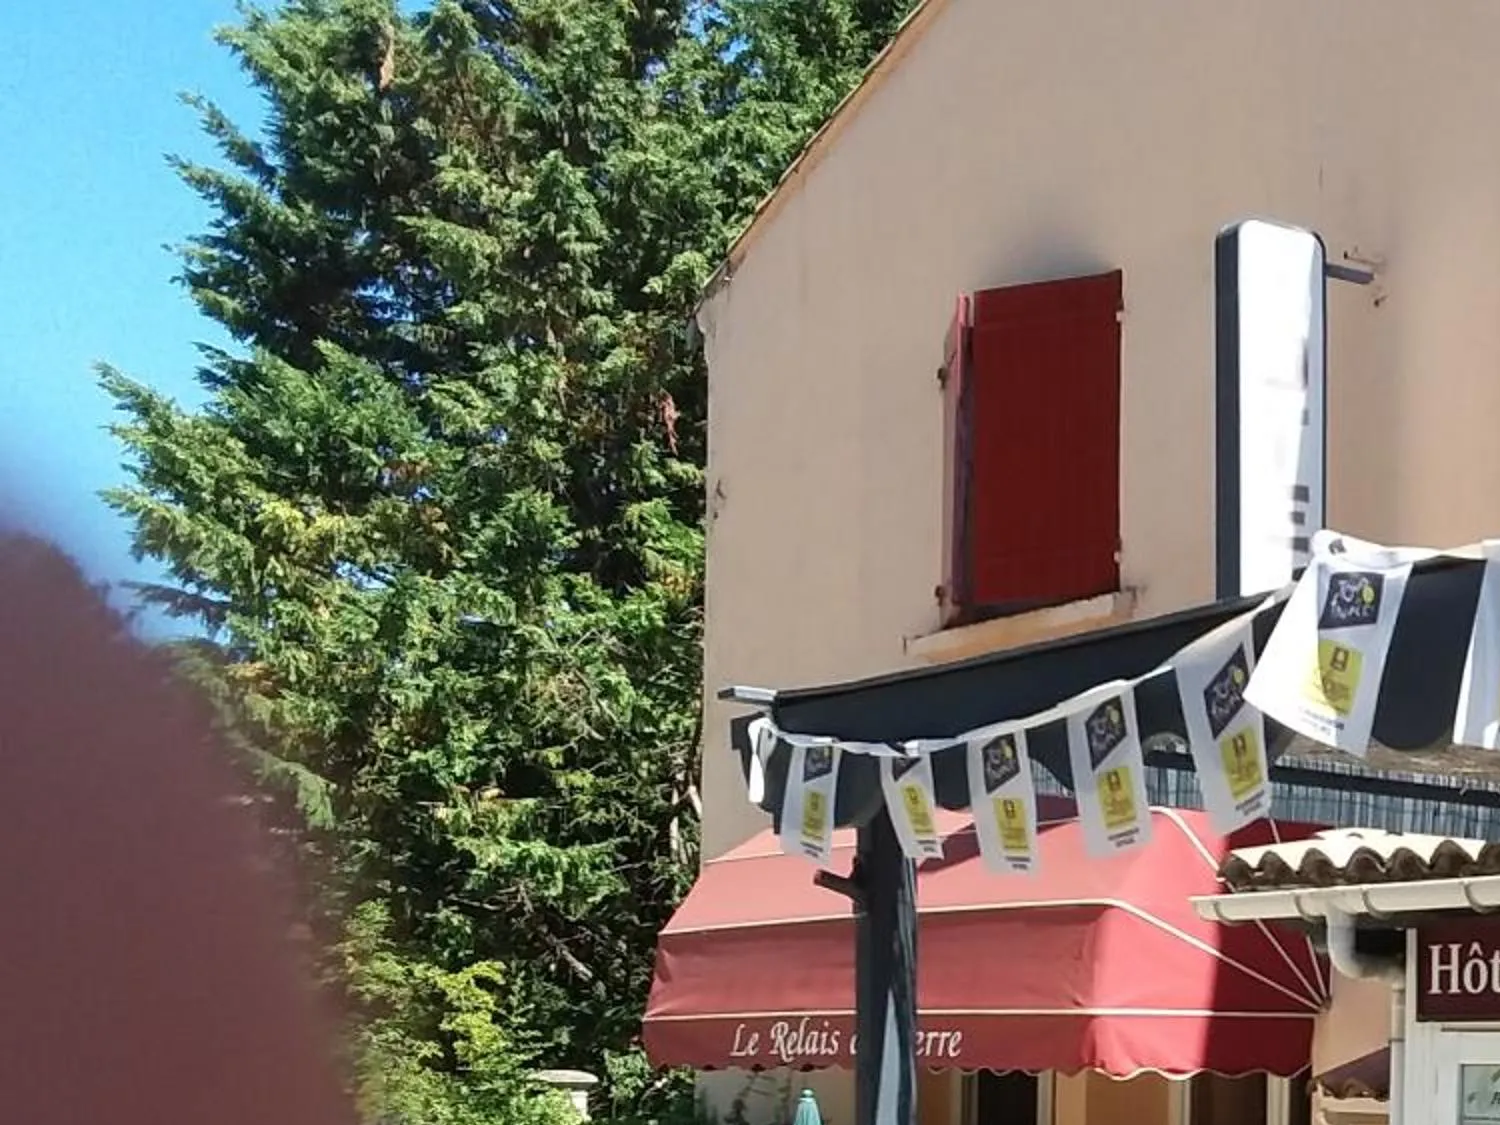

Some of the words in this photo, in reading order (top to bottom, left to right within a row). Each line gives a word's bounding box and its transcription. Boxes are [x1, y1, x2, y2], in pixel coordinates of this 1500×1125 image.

[730, 1023, 759, 1057] Le
[769, 1016, 841, 1062] Relais
[914, 1030, 962, 1058] erre
